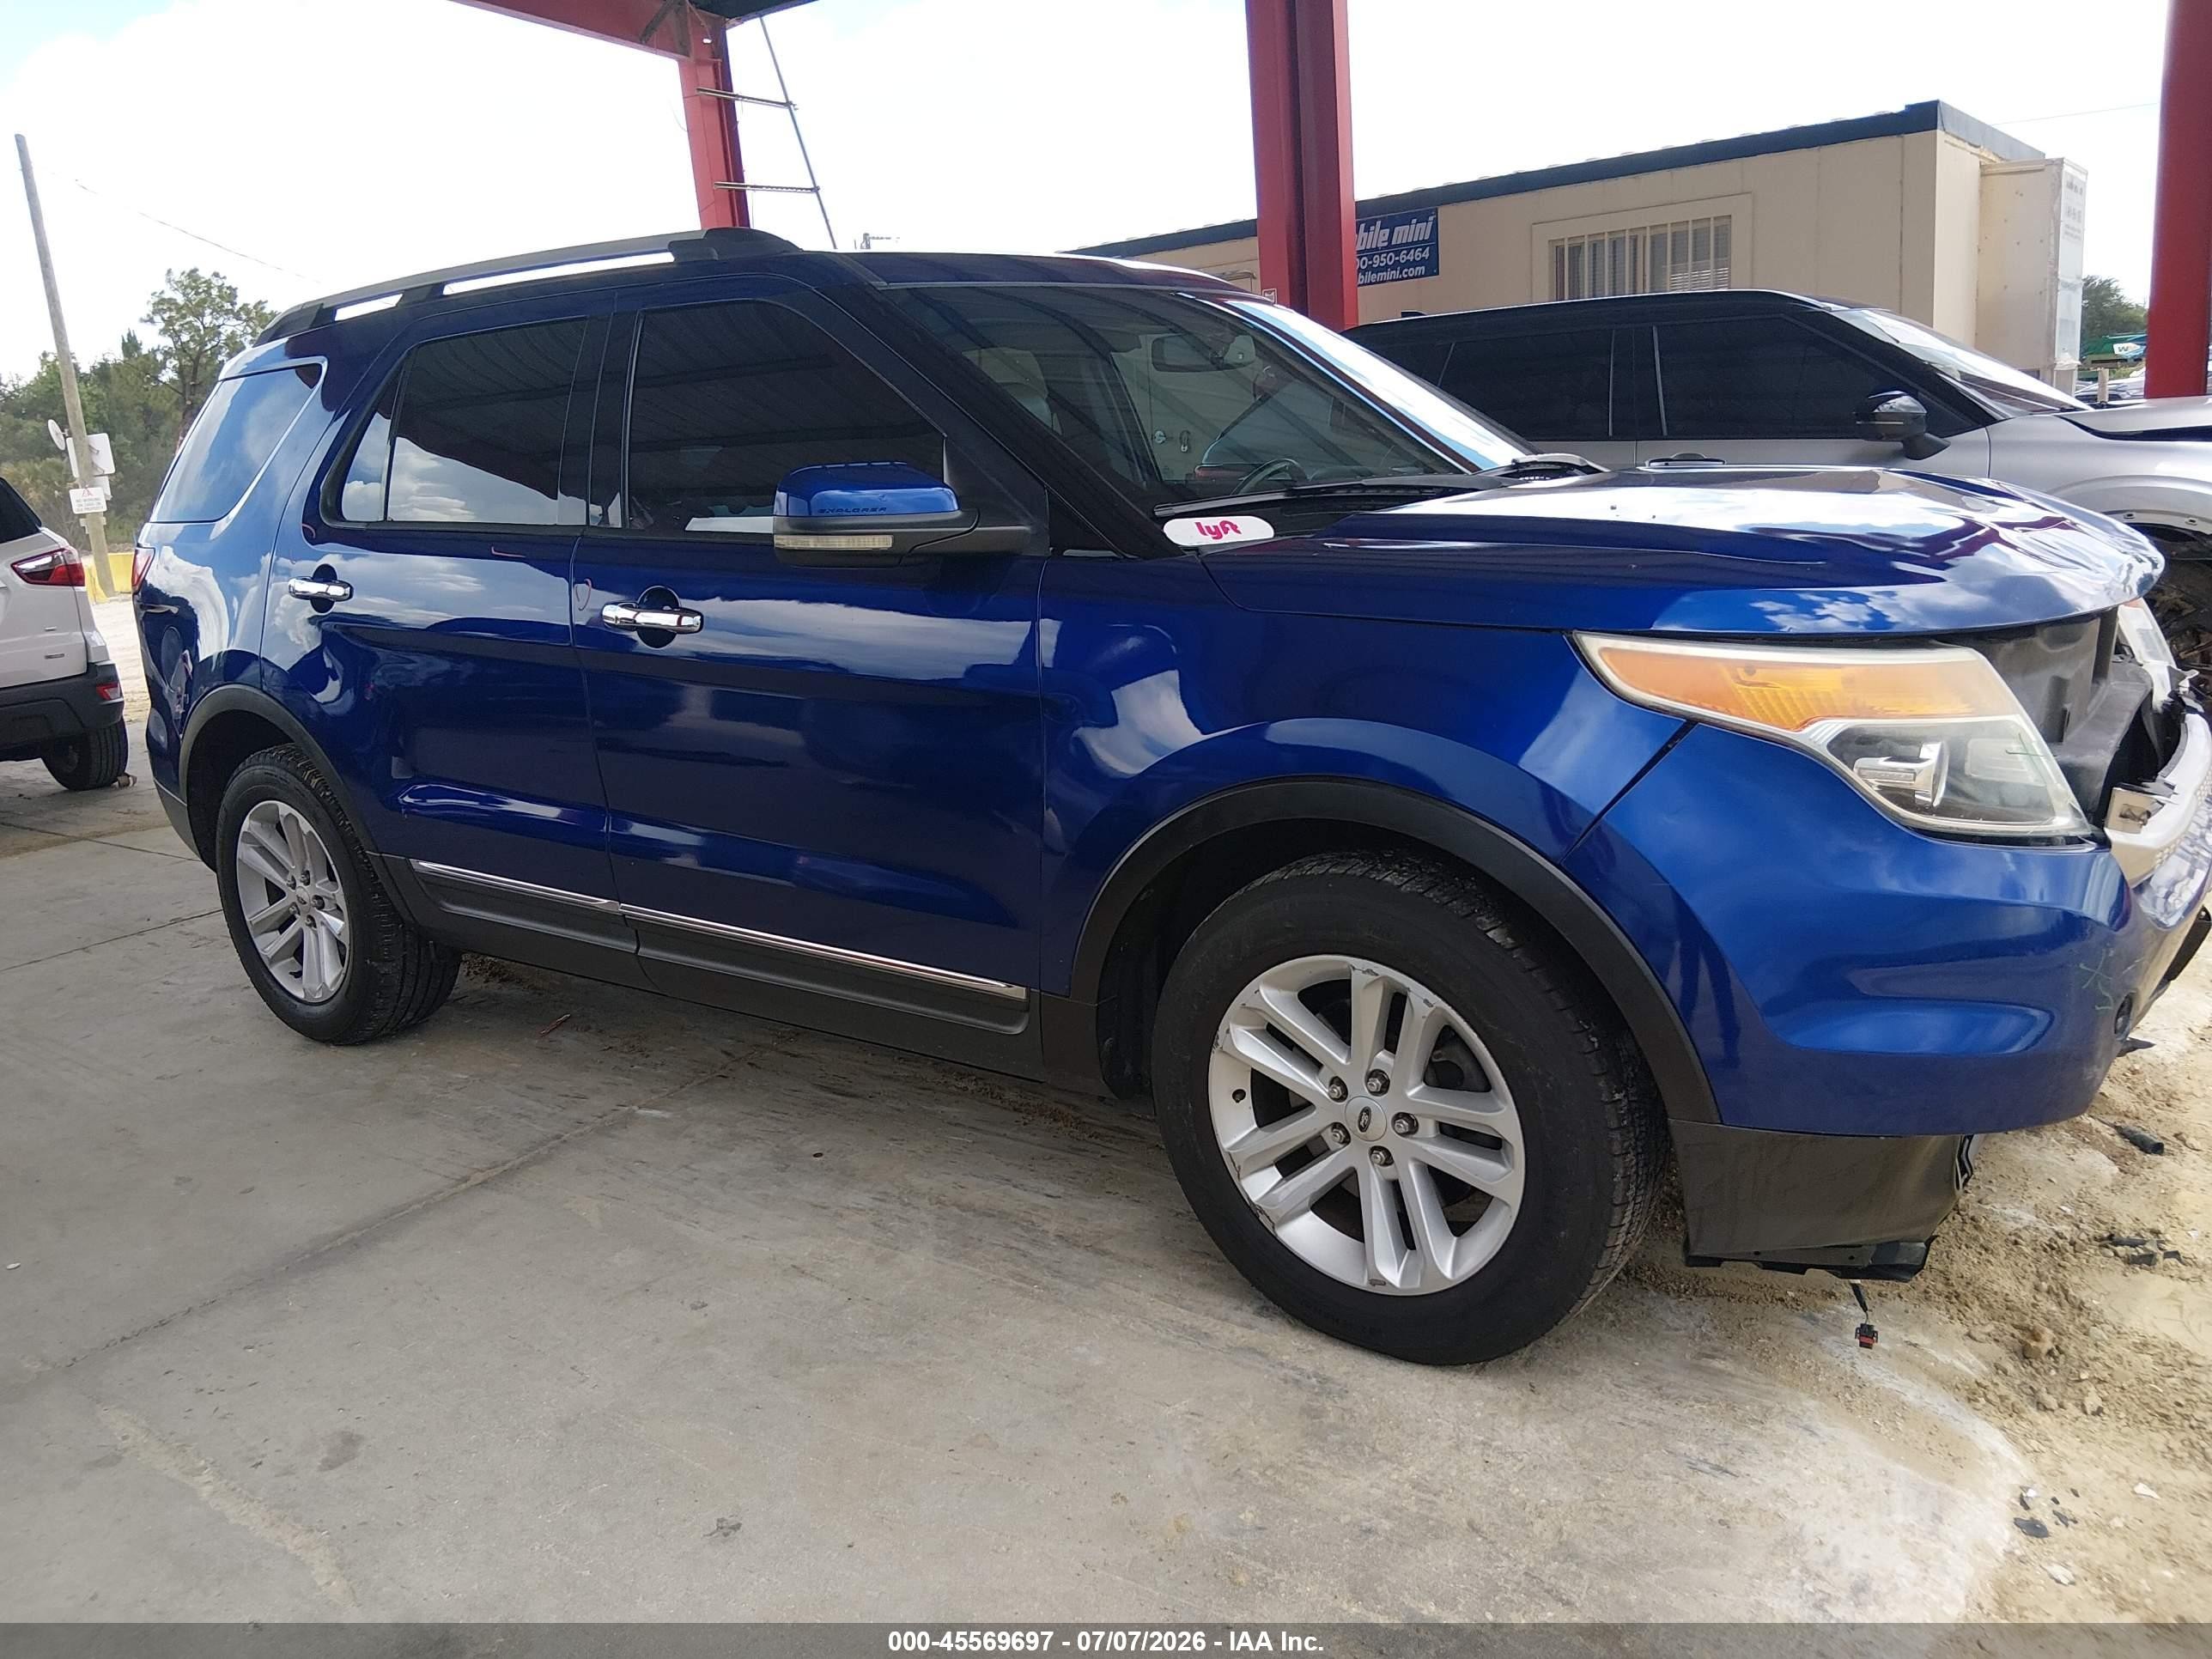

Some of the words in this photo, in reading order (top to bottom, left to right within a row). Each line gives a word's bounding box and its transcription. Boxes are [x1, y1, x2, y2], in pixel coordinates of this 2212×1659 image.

[1356, 221, 1389, 250] bile
[1392, 216, 1433, 245] mini
[1358, 266, 1425, 284] bilemini.com
[1194, 520, 1242, 540] lyft
